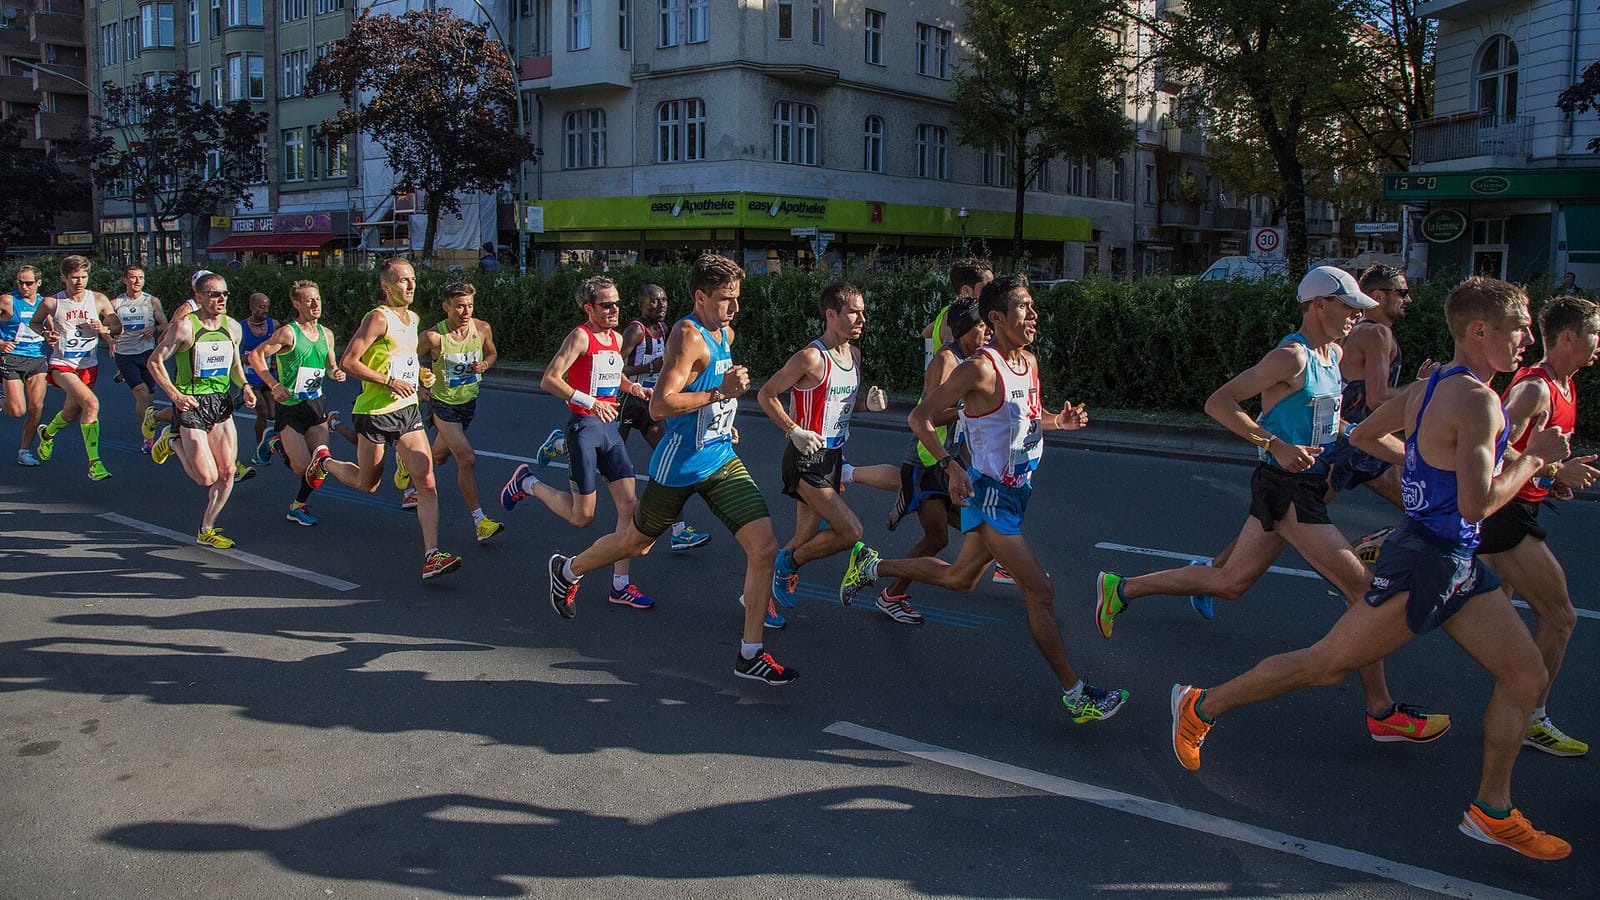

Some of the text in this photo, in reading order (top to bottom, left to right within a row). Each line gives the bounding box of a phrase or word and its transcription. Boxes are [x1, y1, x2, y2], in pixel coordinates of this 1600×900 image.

[1394, 178, 1408, 189] 15
[651, 199, 735, 214] easy Apotheke
[748, 200, 826, 214] easy Apotheke
[1260, 234, 1274, 245] 30
[67, 337, 95, 348] 97
[708, 410, 732, 431] 87
